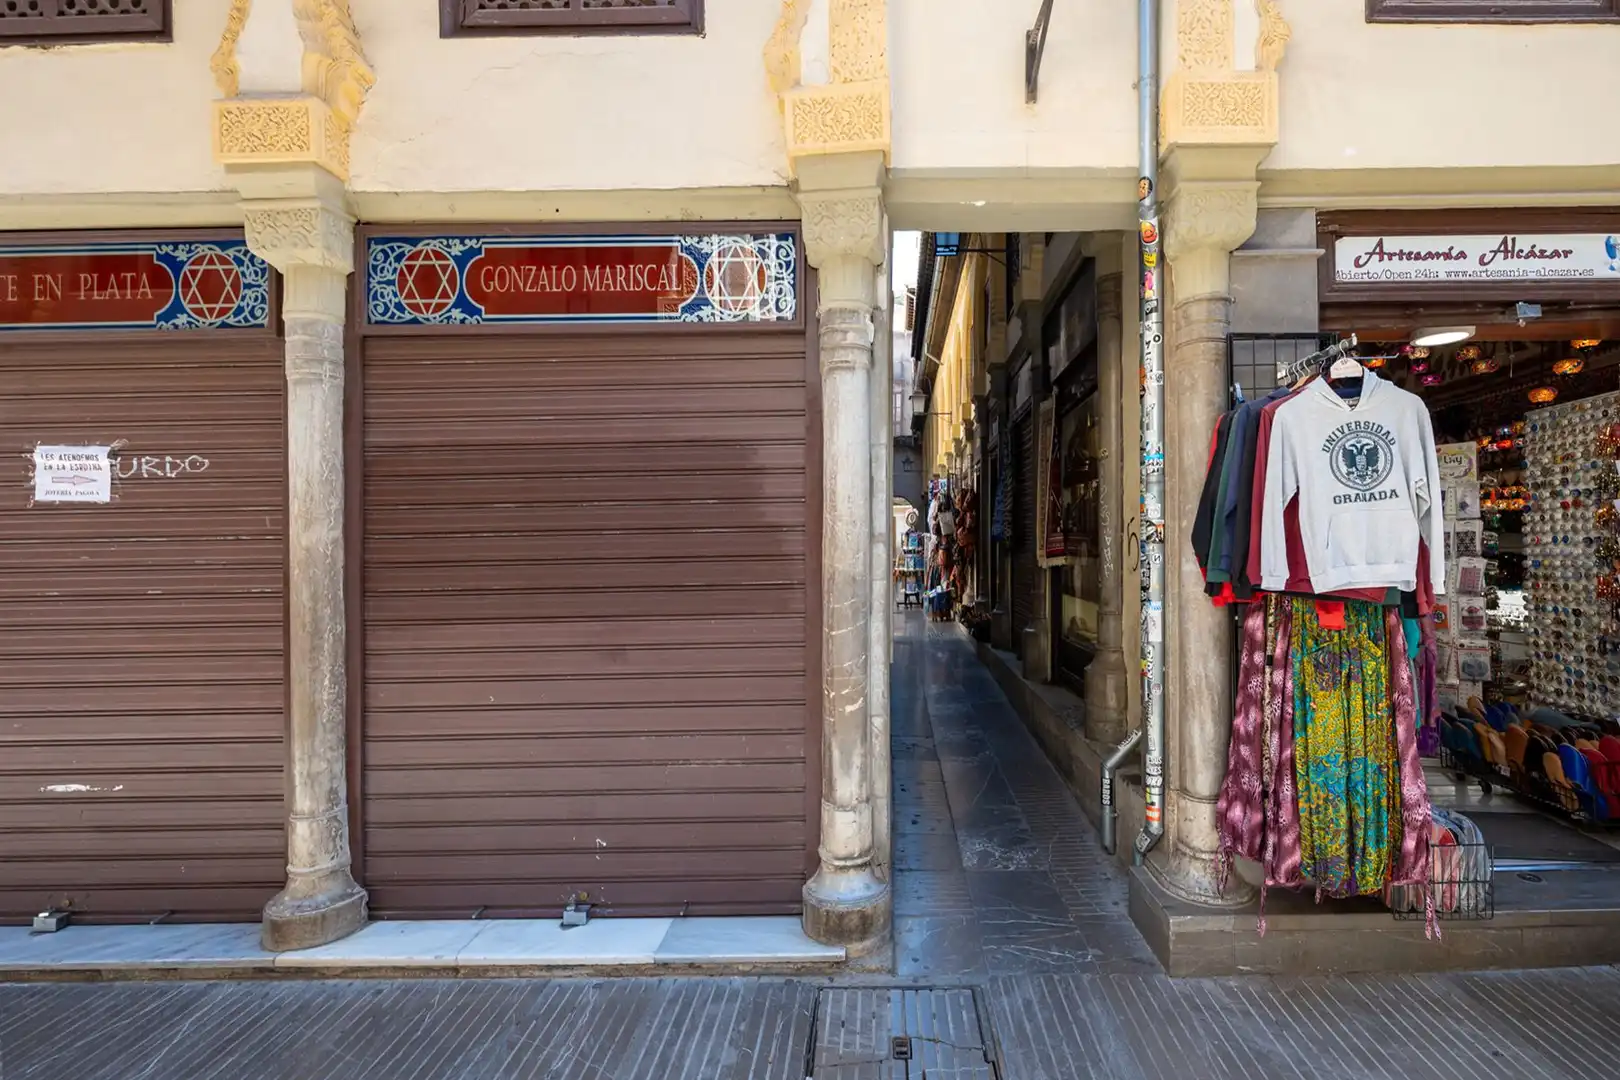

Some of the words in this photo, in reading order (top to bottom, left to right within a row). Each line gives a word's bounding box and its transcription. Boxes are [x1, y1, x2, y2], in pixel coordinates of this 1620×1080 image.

[1354, 237, 1468, 268] Artesanía
[1478, 235, 1573, 266] Alcázar
[32, 273, 63, 301] EN
[79, 272, 153, 300] PLATA
[480, 265, 577, 293] GONZALO
[583, 264, 682, 292] MARISCAL
[1322, 420, 1397, 453] UNIVERSIDAD
[1333, 489, 1400, 505] GRANADA
